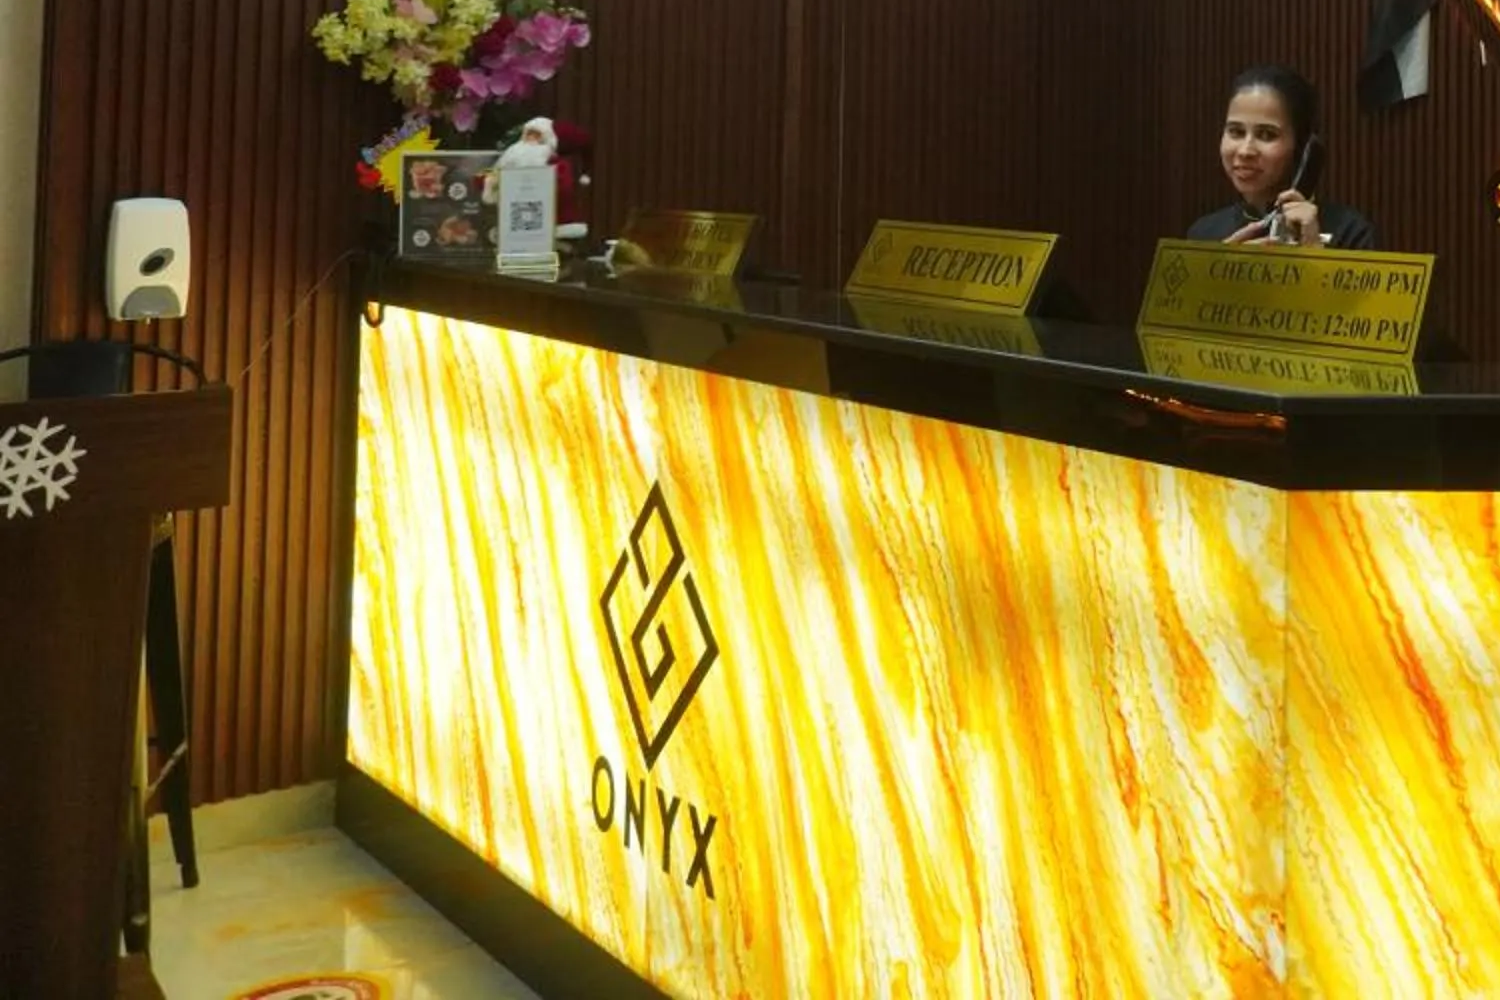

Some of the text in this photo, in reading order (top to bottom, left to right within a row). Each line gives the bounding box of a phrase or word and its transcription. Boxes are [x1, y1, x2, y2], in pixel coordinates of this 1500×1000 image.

[903, 245, 1025, 288] RECEPTION
[1208, 258, 1304, 284] CHECK-IN
[1332, 269, 1381, 291] 02:00
[1387, 271, 1421, 297] PM
[1198, 302, 1411, 343] CHECK-OUT: 12:00 PM
[591, 754, 718, 900] ONYX
